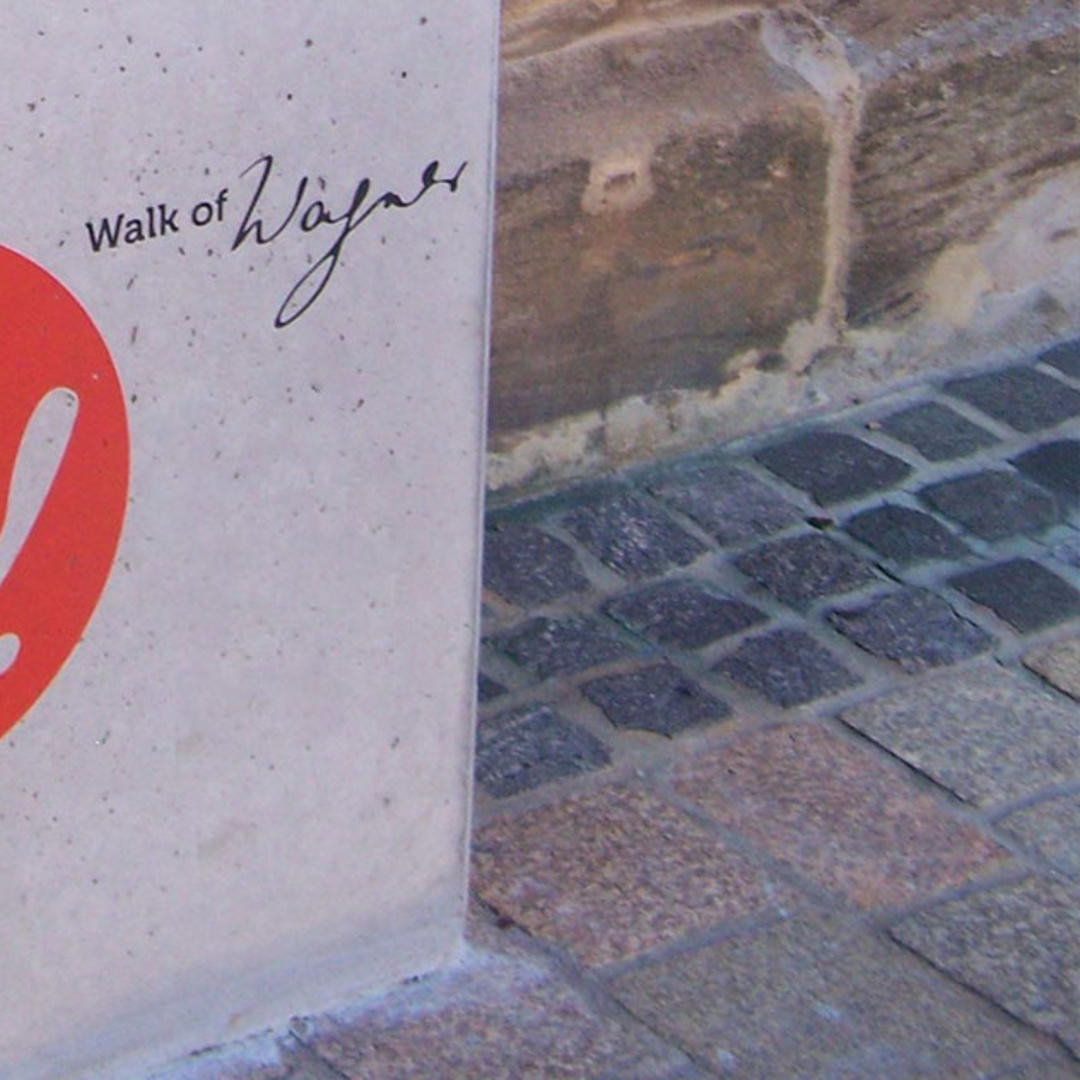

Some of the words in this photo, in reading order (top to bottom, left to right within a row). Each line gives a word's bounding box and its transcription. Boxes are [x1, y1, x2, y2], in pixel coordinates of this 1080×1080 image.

[86, 205, 179, 253] Walk
[191, 188, 229, 227] of
[231, 153, 469, 329] Wagner
